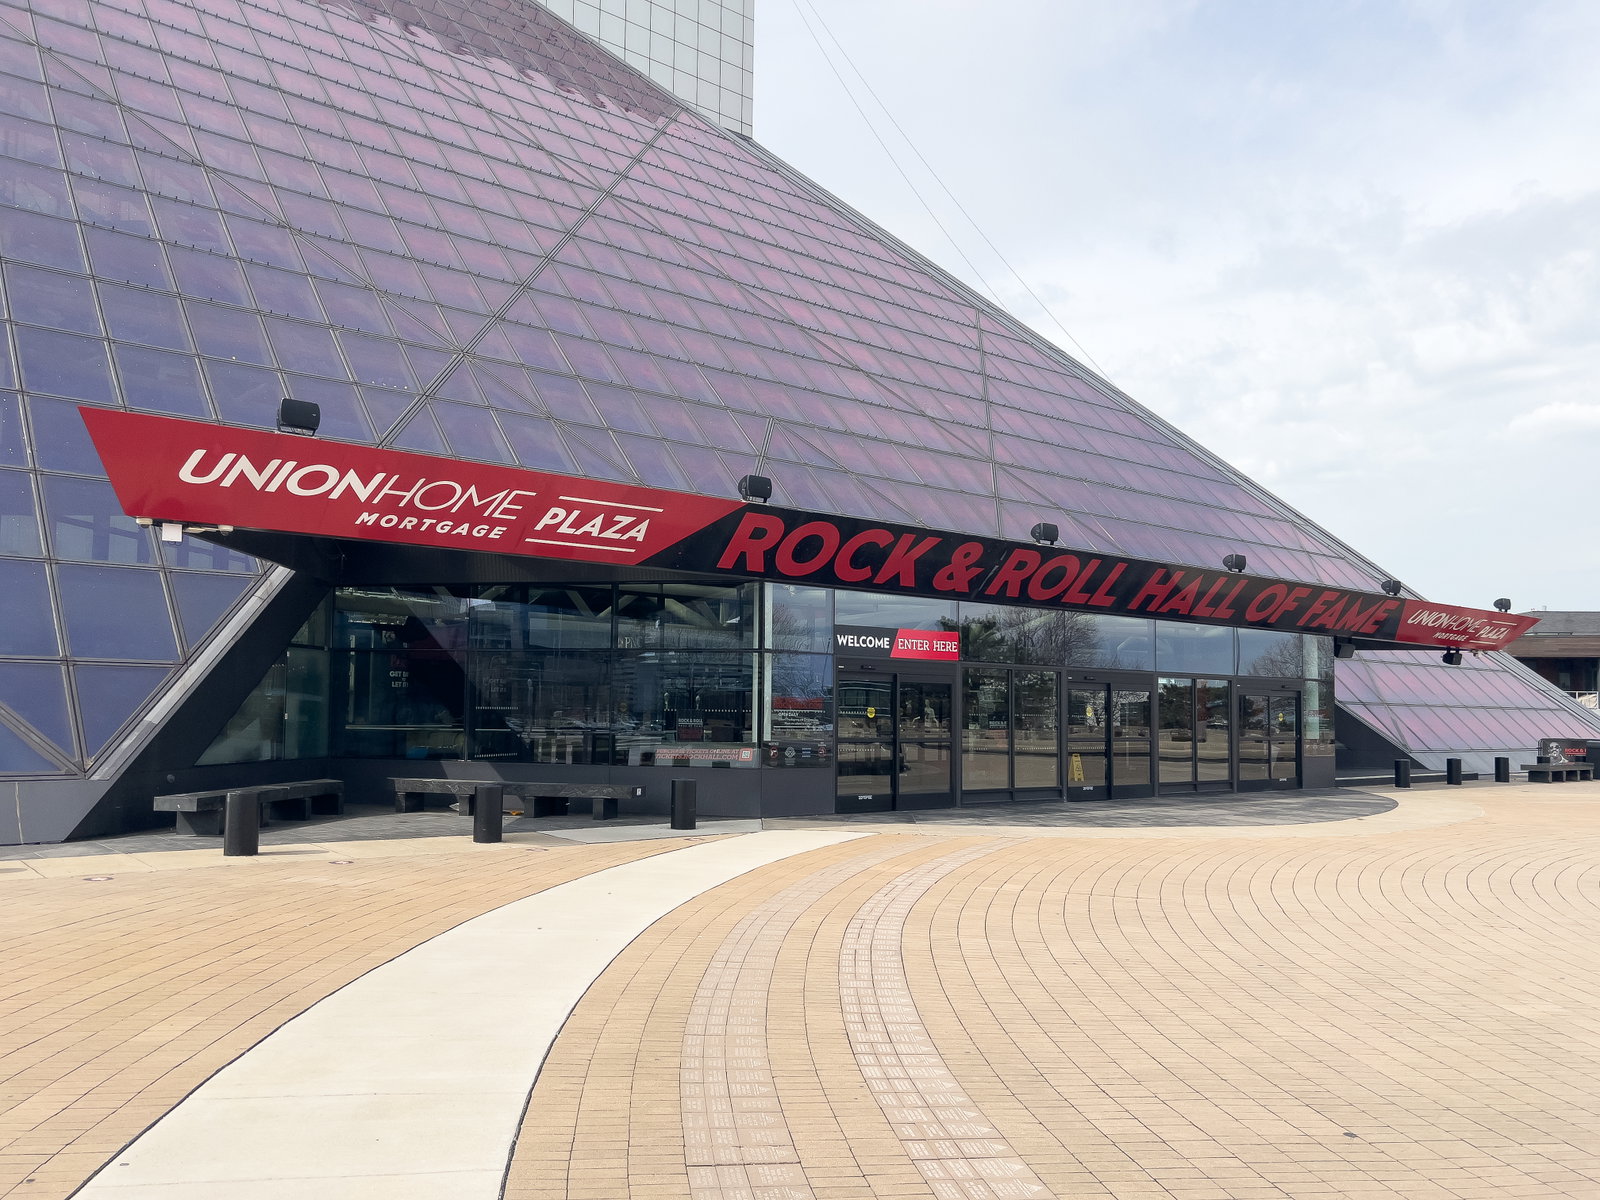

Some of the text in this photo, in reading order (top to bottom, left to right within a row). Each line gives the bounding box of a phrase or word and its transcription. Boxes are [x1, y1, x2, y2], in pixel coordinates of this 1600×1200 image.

[178, 448, 535, 517] UNIONHOME
[355, 511, 508, 540] MORTGAGE
[533, 506, 650, 543] PLAZA
[716, 511, 1400, 634] ROCK & ROLL HALL OF FAME
[1407, 609, 1488, 633] UNIONHOME
[1475, 625, 1511, 640] PLAZA
[837, 634, 958, 653] WELCOME ENTER HERE
[1432, 631, 1469, 642] MORTGAGE
